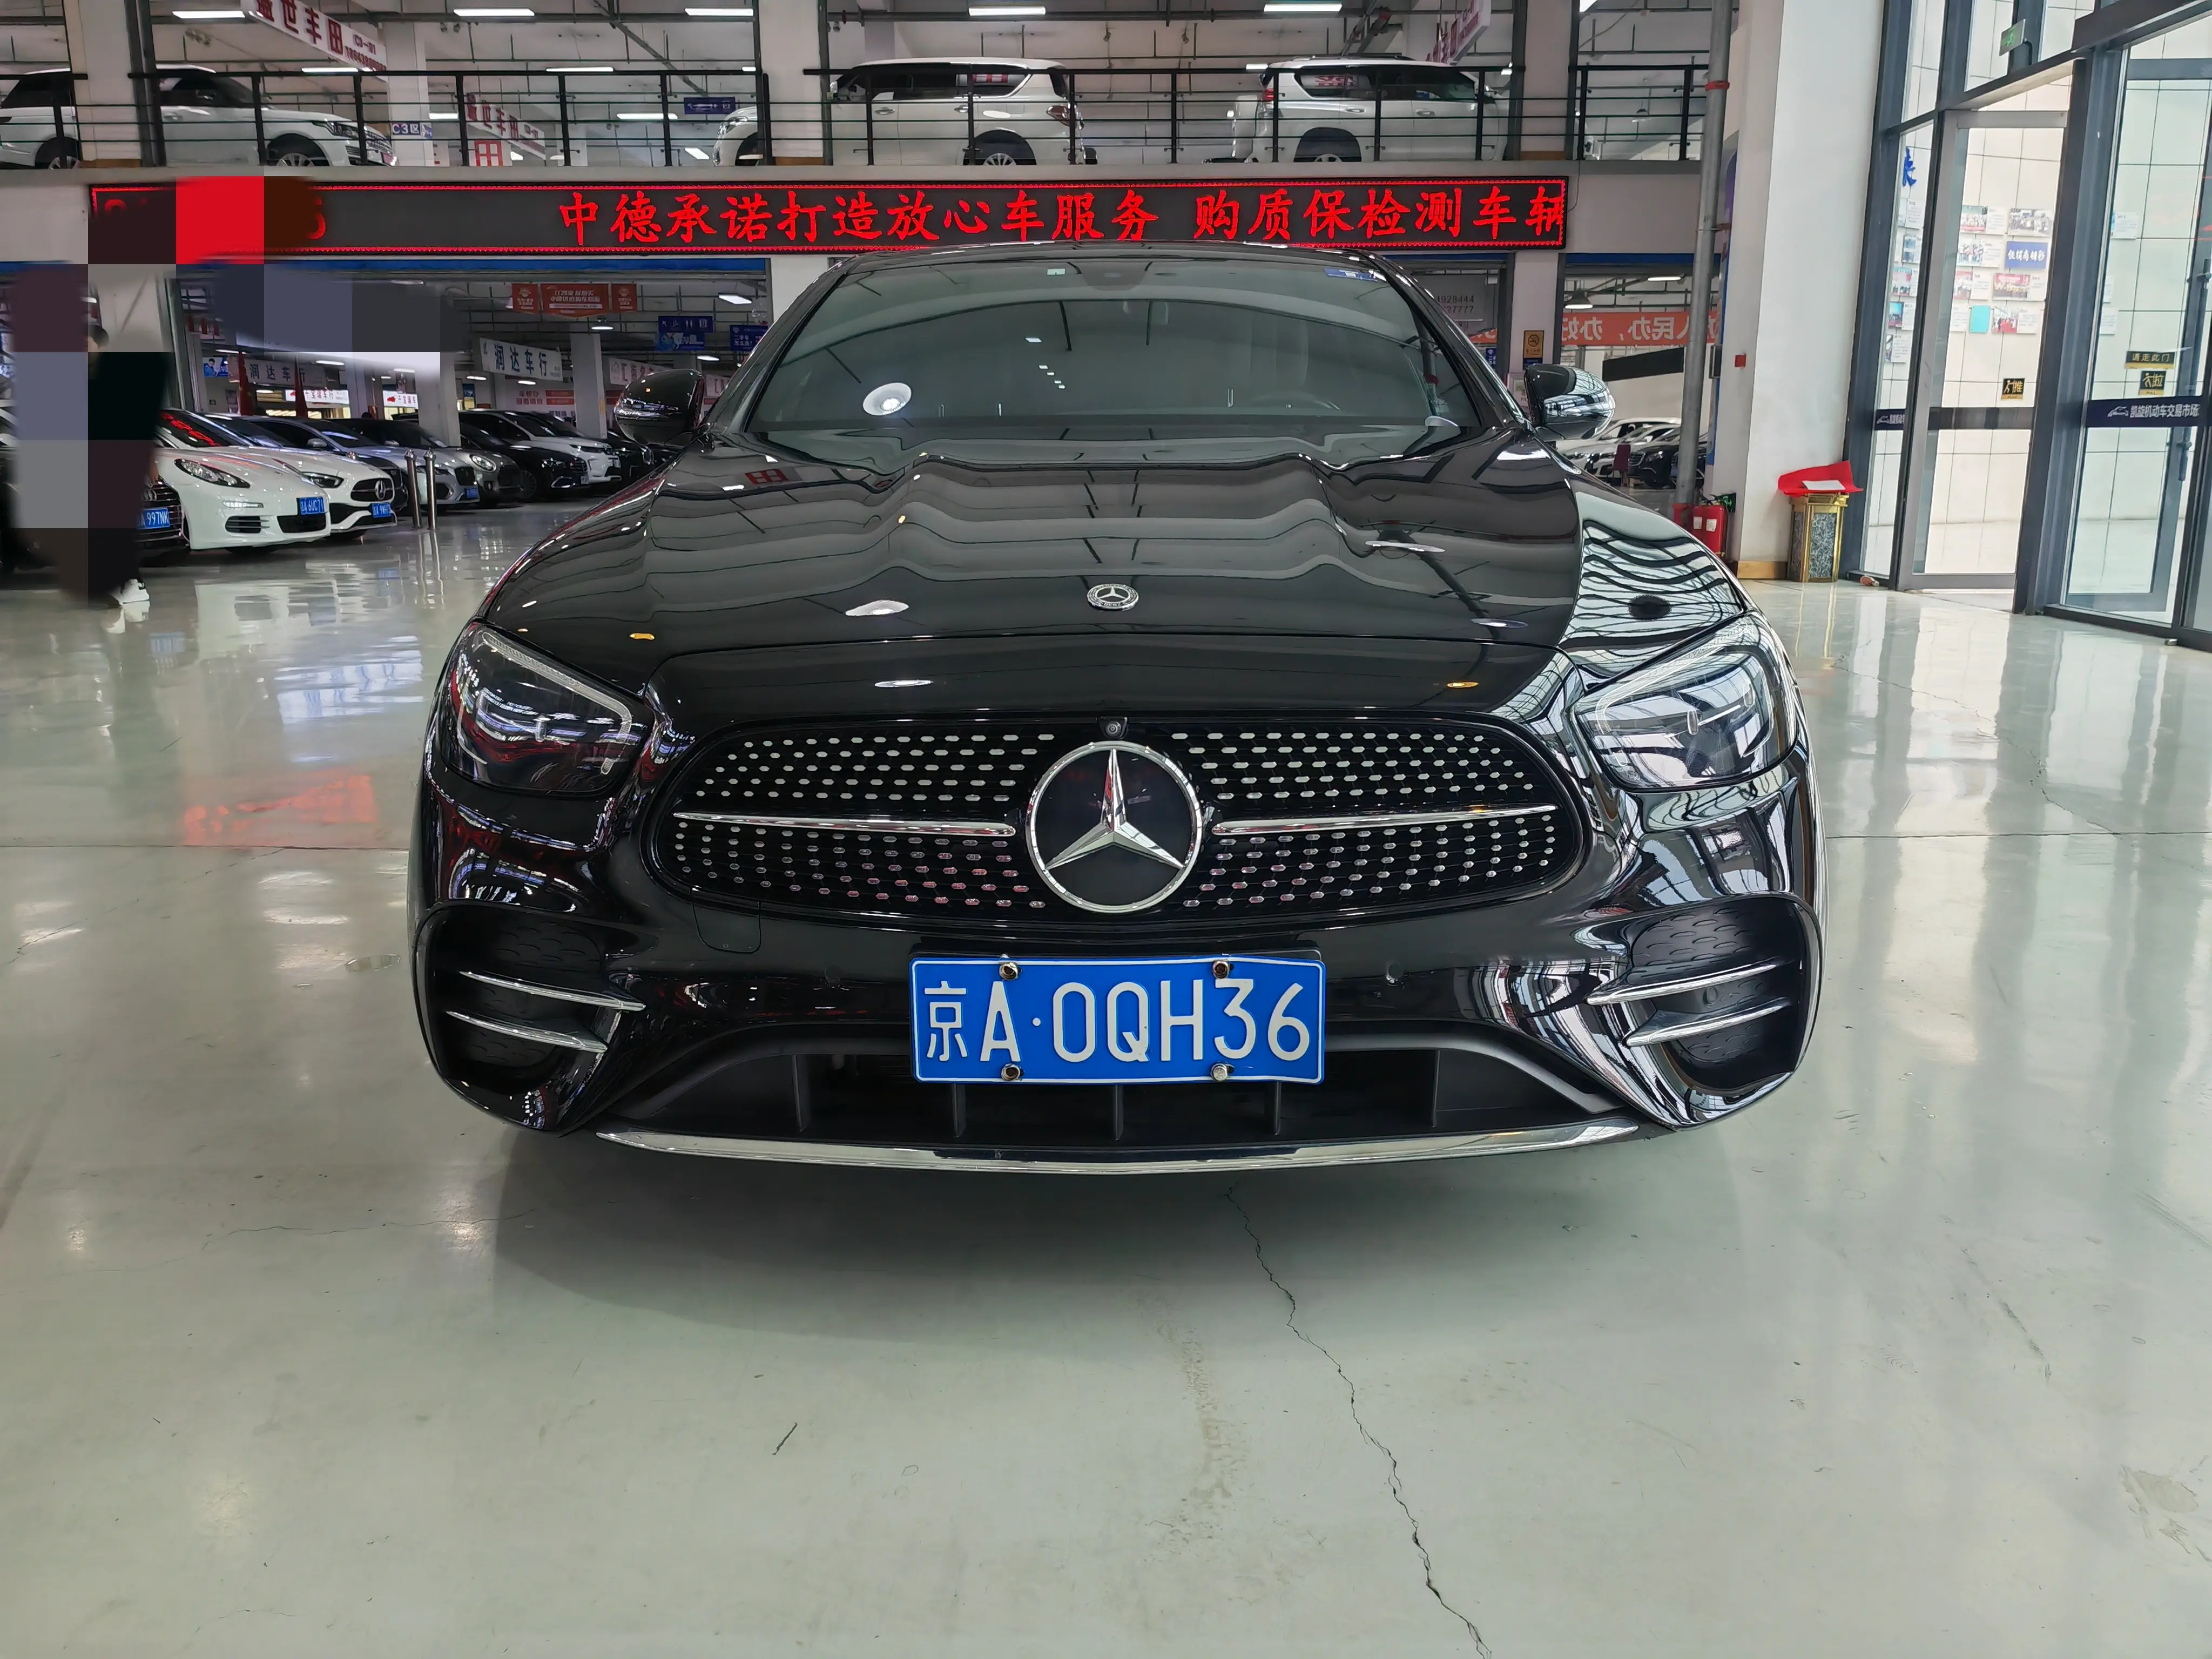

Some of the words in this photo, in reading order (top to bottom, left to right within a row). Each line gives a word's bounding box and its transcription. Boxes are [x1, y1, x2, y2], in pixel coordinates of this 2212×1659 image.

[392, 123, 420, 134] C3区
[559, 191, 1159, 246] 中德承诺打造放心车服务
[1193, 186, 1563, 240] 购质保检测车辆
[494, 343, 547, 377] 润达车行
[2012, 380, 2024, 393] 推
[2152, 372, 2164, 388] 拉
[2130, 404, 2200, 419] 凯旋机动车交易市场
[924, 979, 1310, 1063] 京A·0QH36
